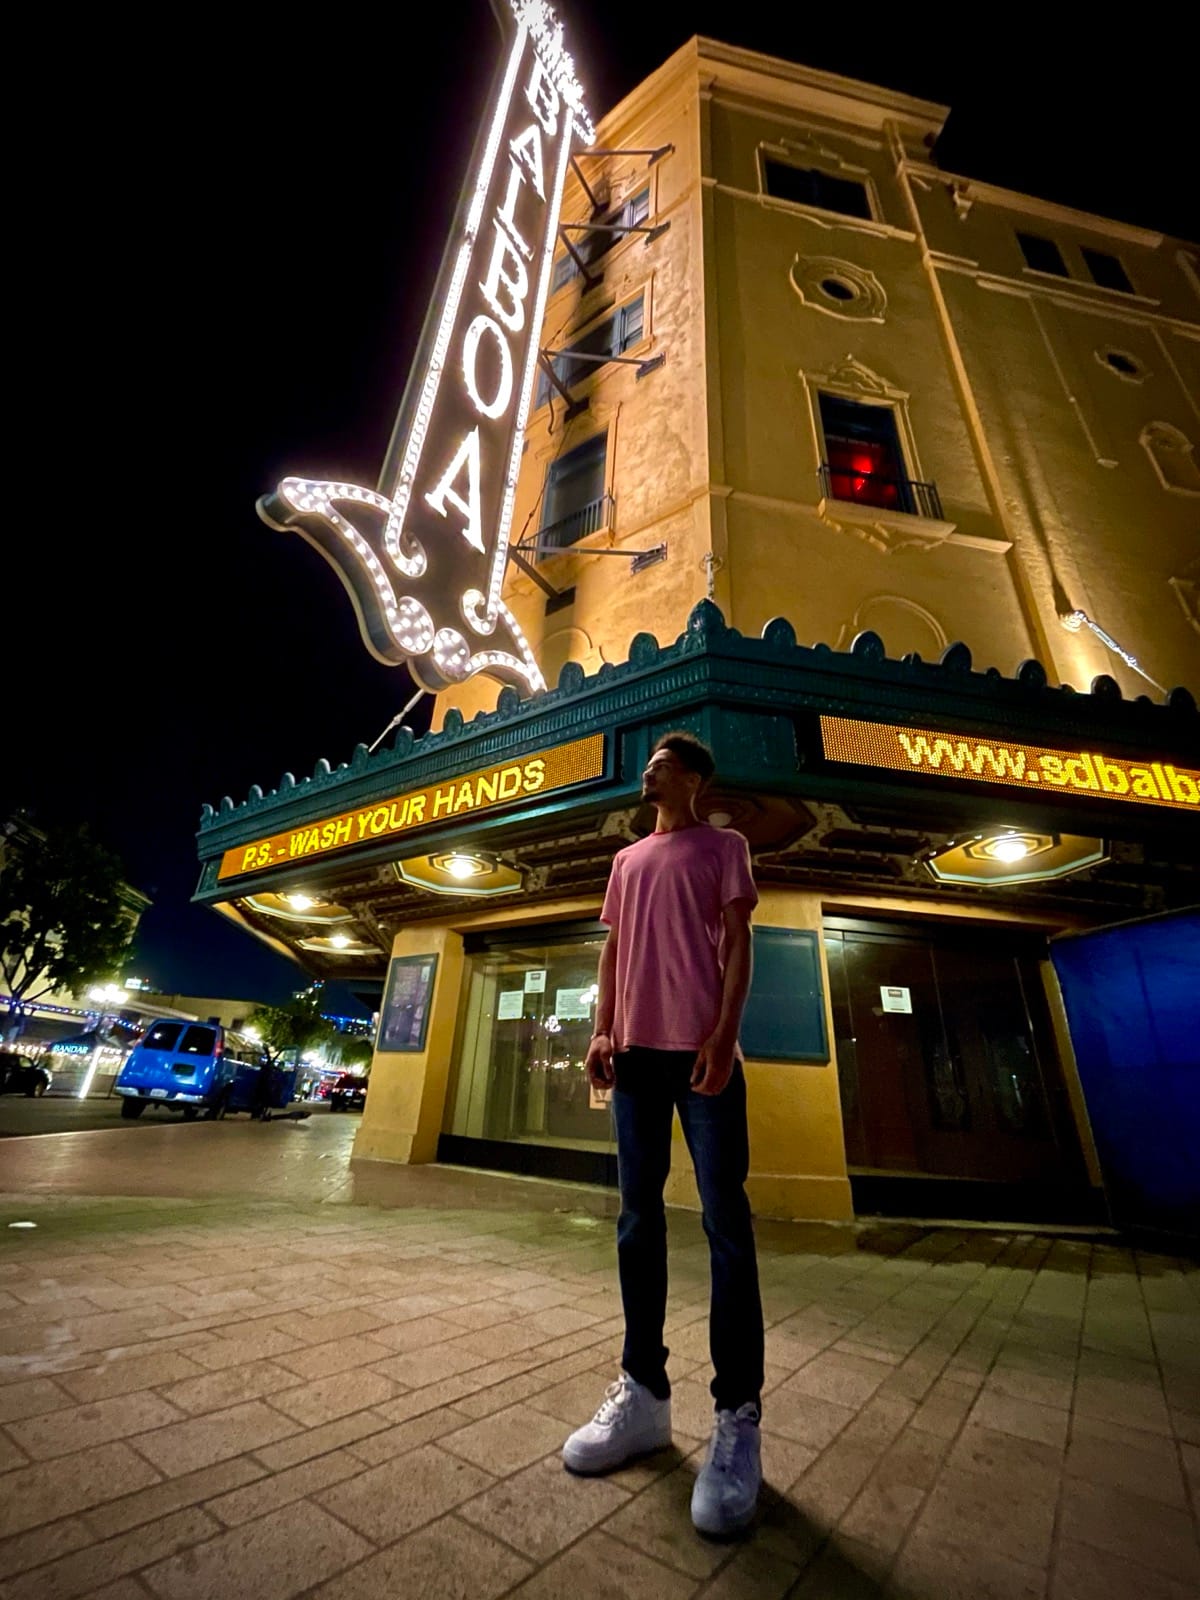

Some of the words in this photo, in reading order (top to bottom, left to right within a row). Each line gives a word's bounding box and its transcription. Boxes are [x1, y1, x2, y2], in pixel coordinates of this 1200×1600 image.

[424, 48, 559, 554] BALBOA
[898, 732, 1200, 804] www.sdbalb
[241, 846, 273, 871] P.S.
[289, 818, 352, 857] WASH
[357, 795, 427, 839] YOUR
[432, 759, 546, 817] HANDS
[52, 1044, 90, 1054] BANDAR
